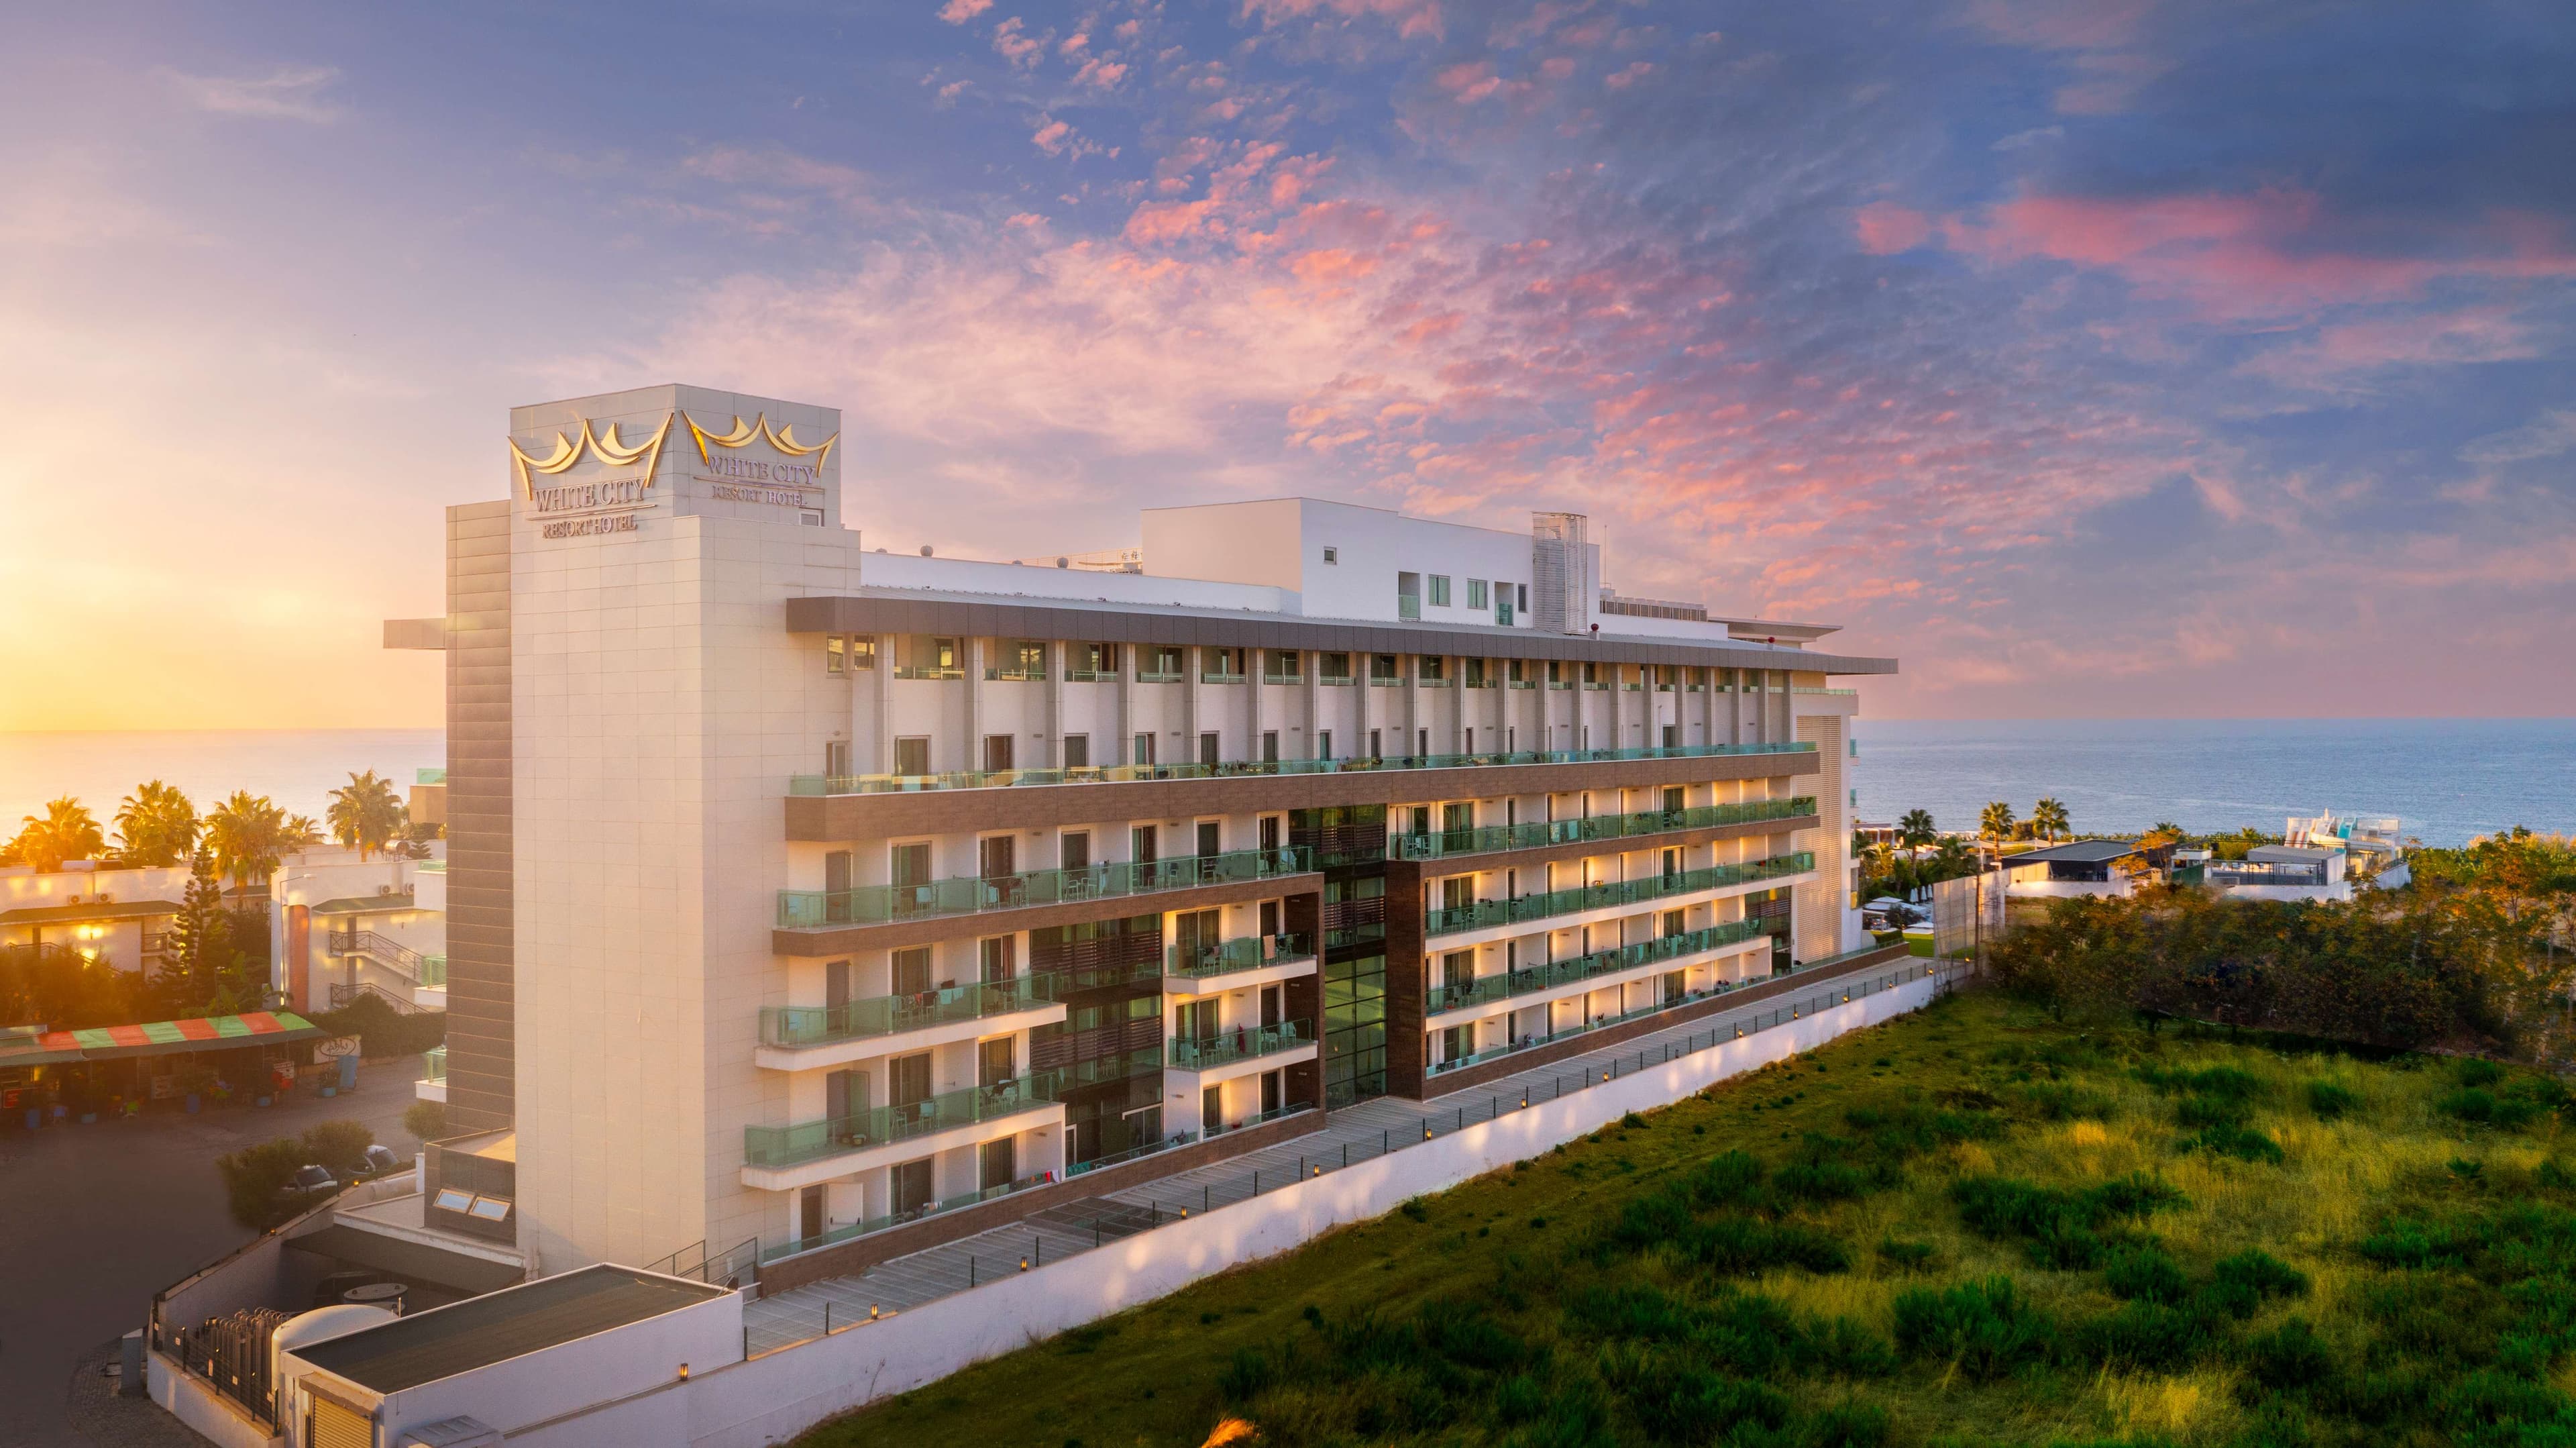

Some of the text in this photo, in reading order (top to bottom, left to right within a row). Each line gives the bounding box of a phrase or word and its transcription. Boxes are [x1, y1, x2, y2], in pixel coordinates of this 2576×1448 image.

[708, 456, 816, 484] WHITE CITY
[534, 478, 645, 511] WHITE CITY
[712, 485, 808, 507] RESORT HOTEL
[543, 514, 638, 538] RESORT HOTEL
